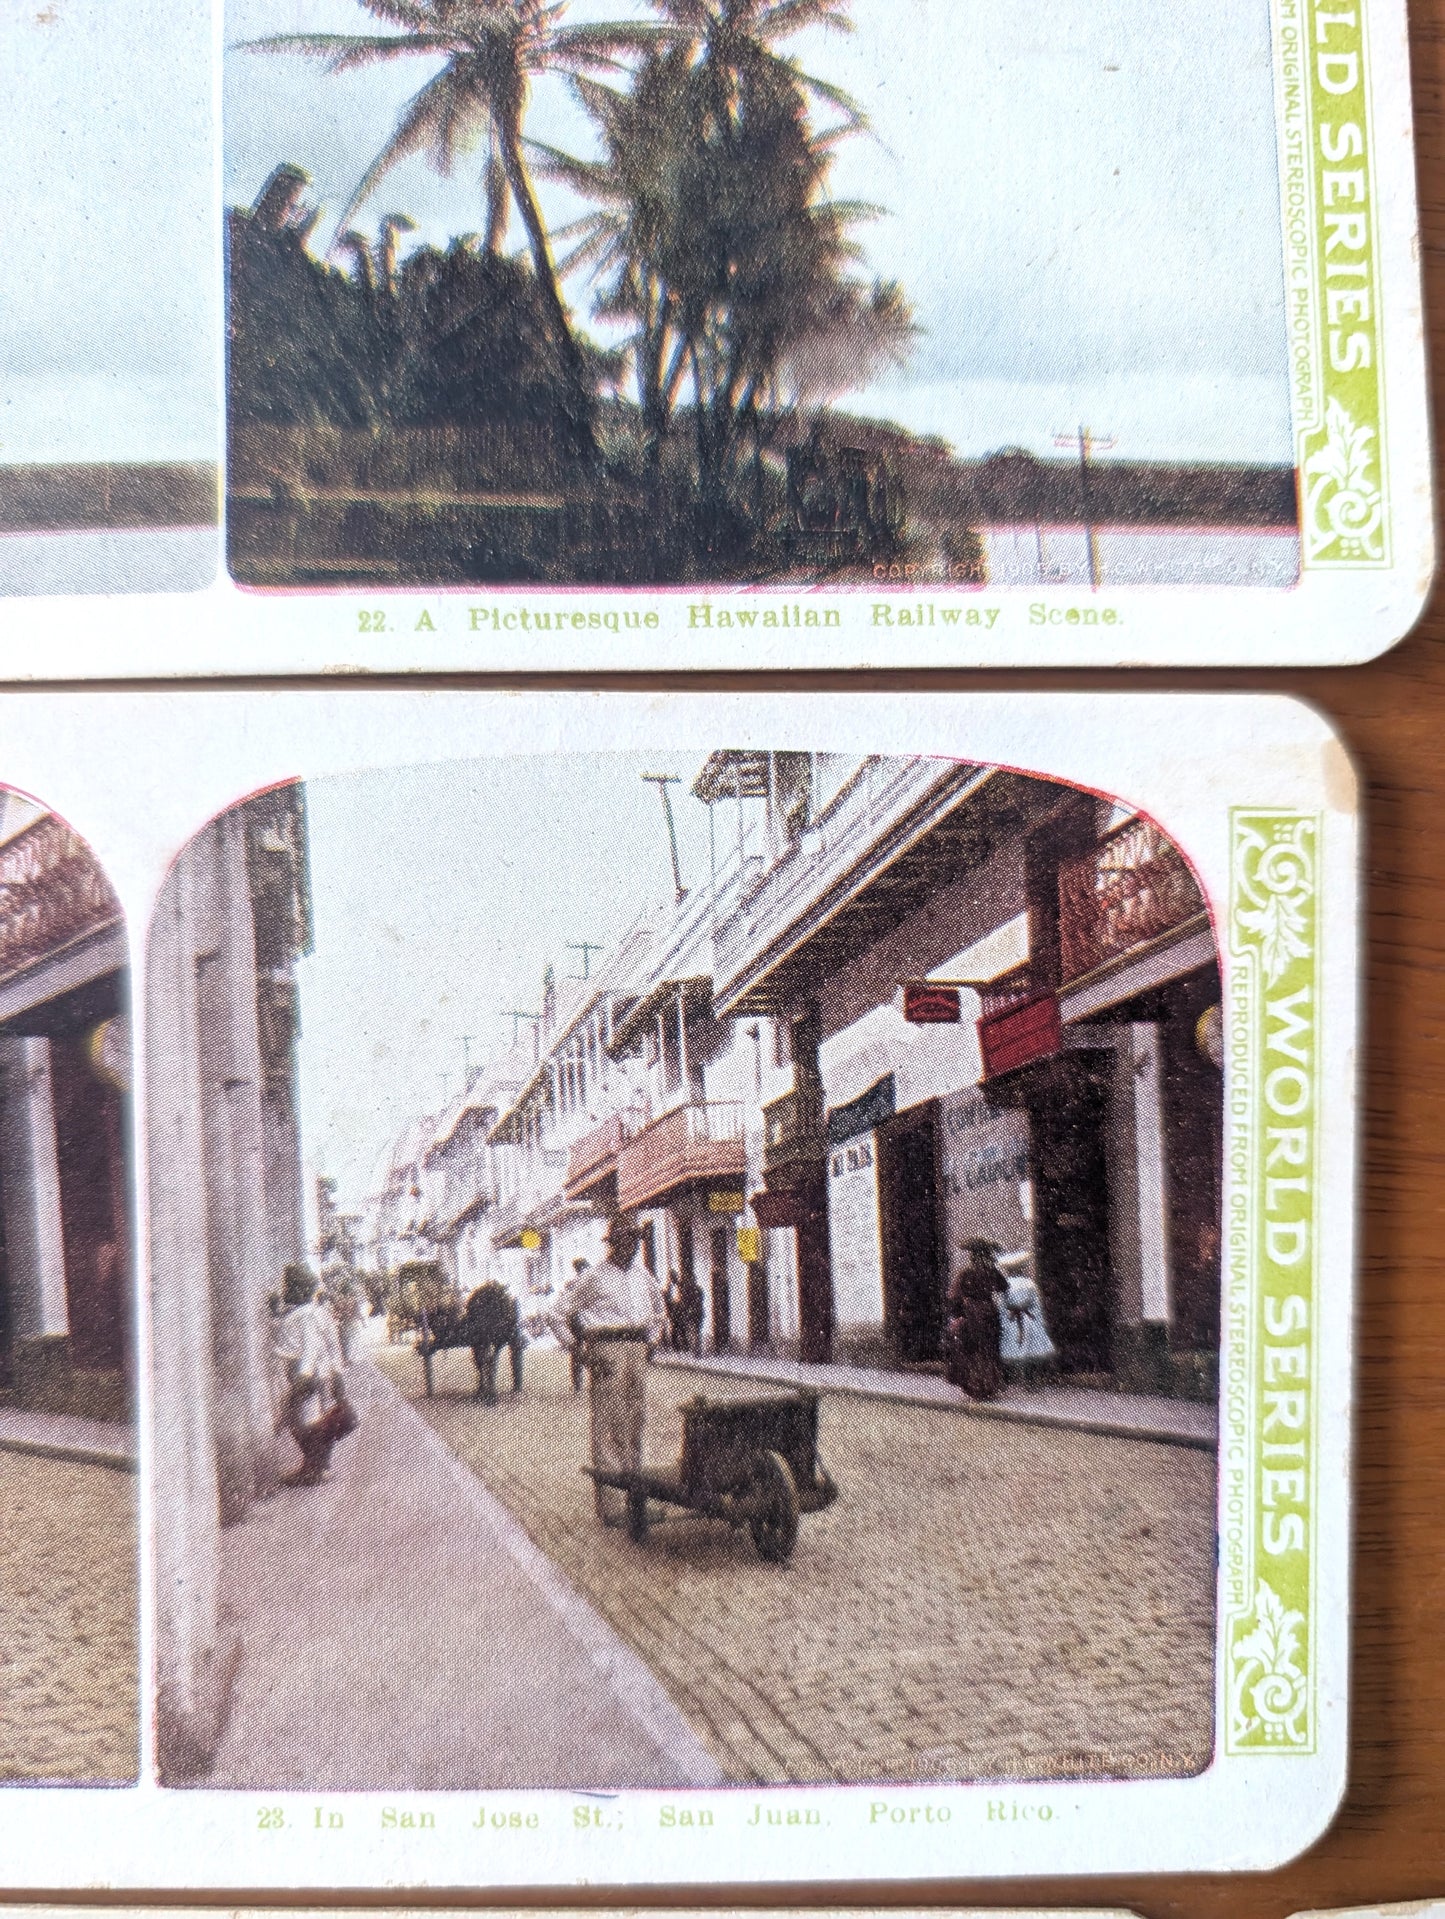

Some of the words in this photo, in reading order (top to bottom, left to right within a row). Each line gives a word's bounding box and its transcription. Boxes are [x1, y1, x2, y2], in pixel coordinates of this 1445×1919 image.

[1281, 26, 1301, 123] ORIGINAL
[1314, 0, 1359, 95] LD
[1285, 129, 1308, 280] STEREOSCOPIC
[1320, 122, 1372, 373] SERIES
[1291, 287, 1314, 421] PHOTOGRAPH
[357, 610, 396, 634] 22.
[414, 609, 438, 632] A
[468, 607, 660, 634] Picturesque
[687, 604, 842, 629] Hawaiian
[870, 603, 1000, 630] Railway
[1028, 602, 1124, 626] Scene.
[872, 561, 991, 579] COPYRIGH
[1059, 560, 1088, 577] BY
[1231, 966, 1249, 1116] REPRODUCED
[1230, 1123, 1249, 1186] FROM
[1264, 984, 1311, 1266] WORLD
[1229, 1193, 1247, 1296] ORIGINAL
[1227, 1302, 1246, 1461] STEREOSCOPIC
[1261, 1295, 1308, 1556] SERIES
[1226, 1468, 1246, 1606] PHOTOGRAPH
[256, 1807, 293, 1829] 23.
[314, 1807, 344, 1829] In
[382, 1806, 436, 1829] San
[472, 1807, 540, 1829] Jose
[659, 1804, 714, 1827] San
[869, 1801, 952, 1825] Porto
